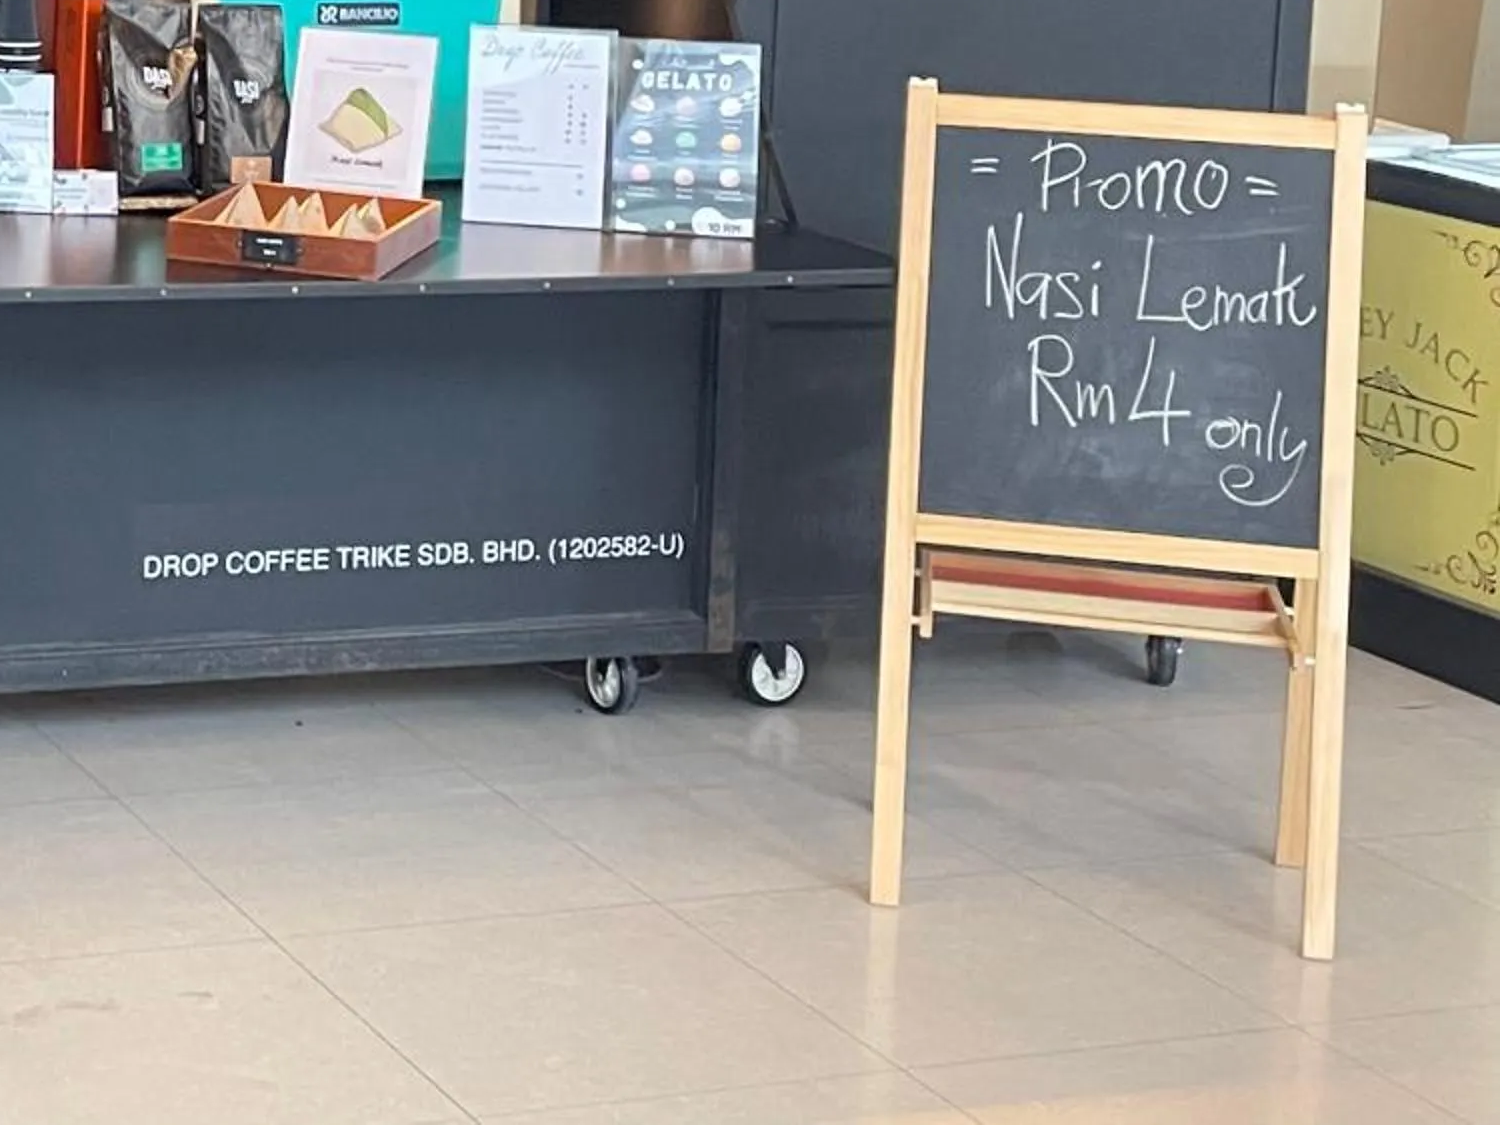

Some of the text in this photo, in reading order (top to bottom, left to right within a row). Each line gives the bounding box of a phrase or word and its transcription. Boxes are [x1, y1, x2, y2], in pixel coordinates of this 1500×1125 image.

[641, 70, 733, 91] GELATO
[1029, 138, 1230, 215] Promo
[984, 211, 1318, 330] Nasi Lemak
[1404, 321, 1489, 404] JACK
[1204, 388, 1308, 506] only
[143, 532, 685, 579] DROP COFFEE TRIKE SDB. BHD. (1202582-U)
